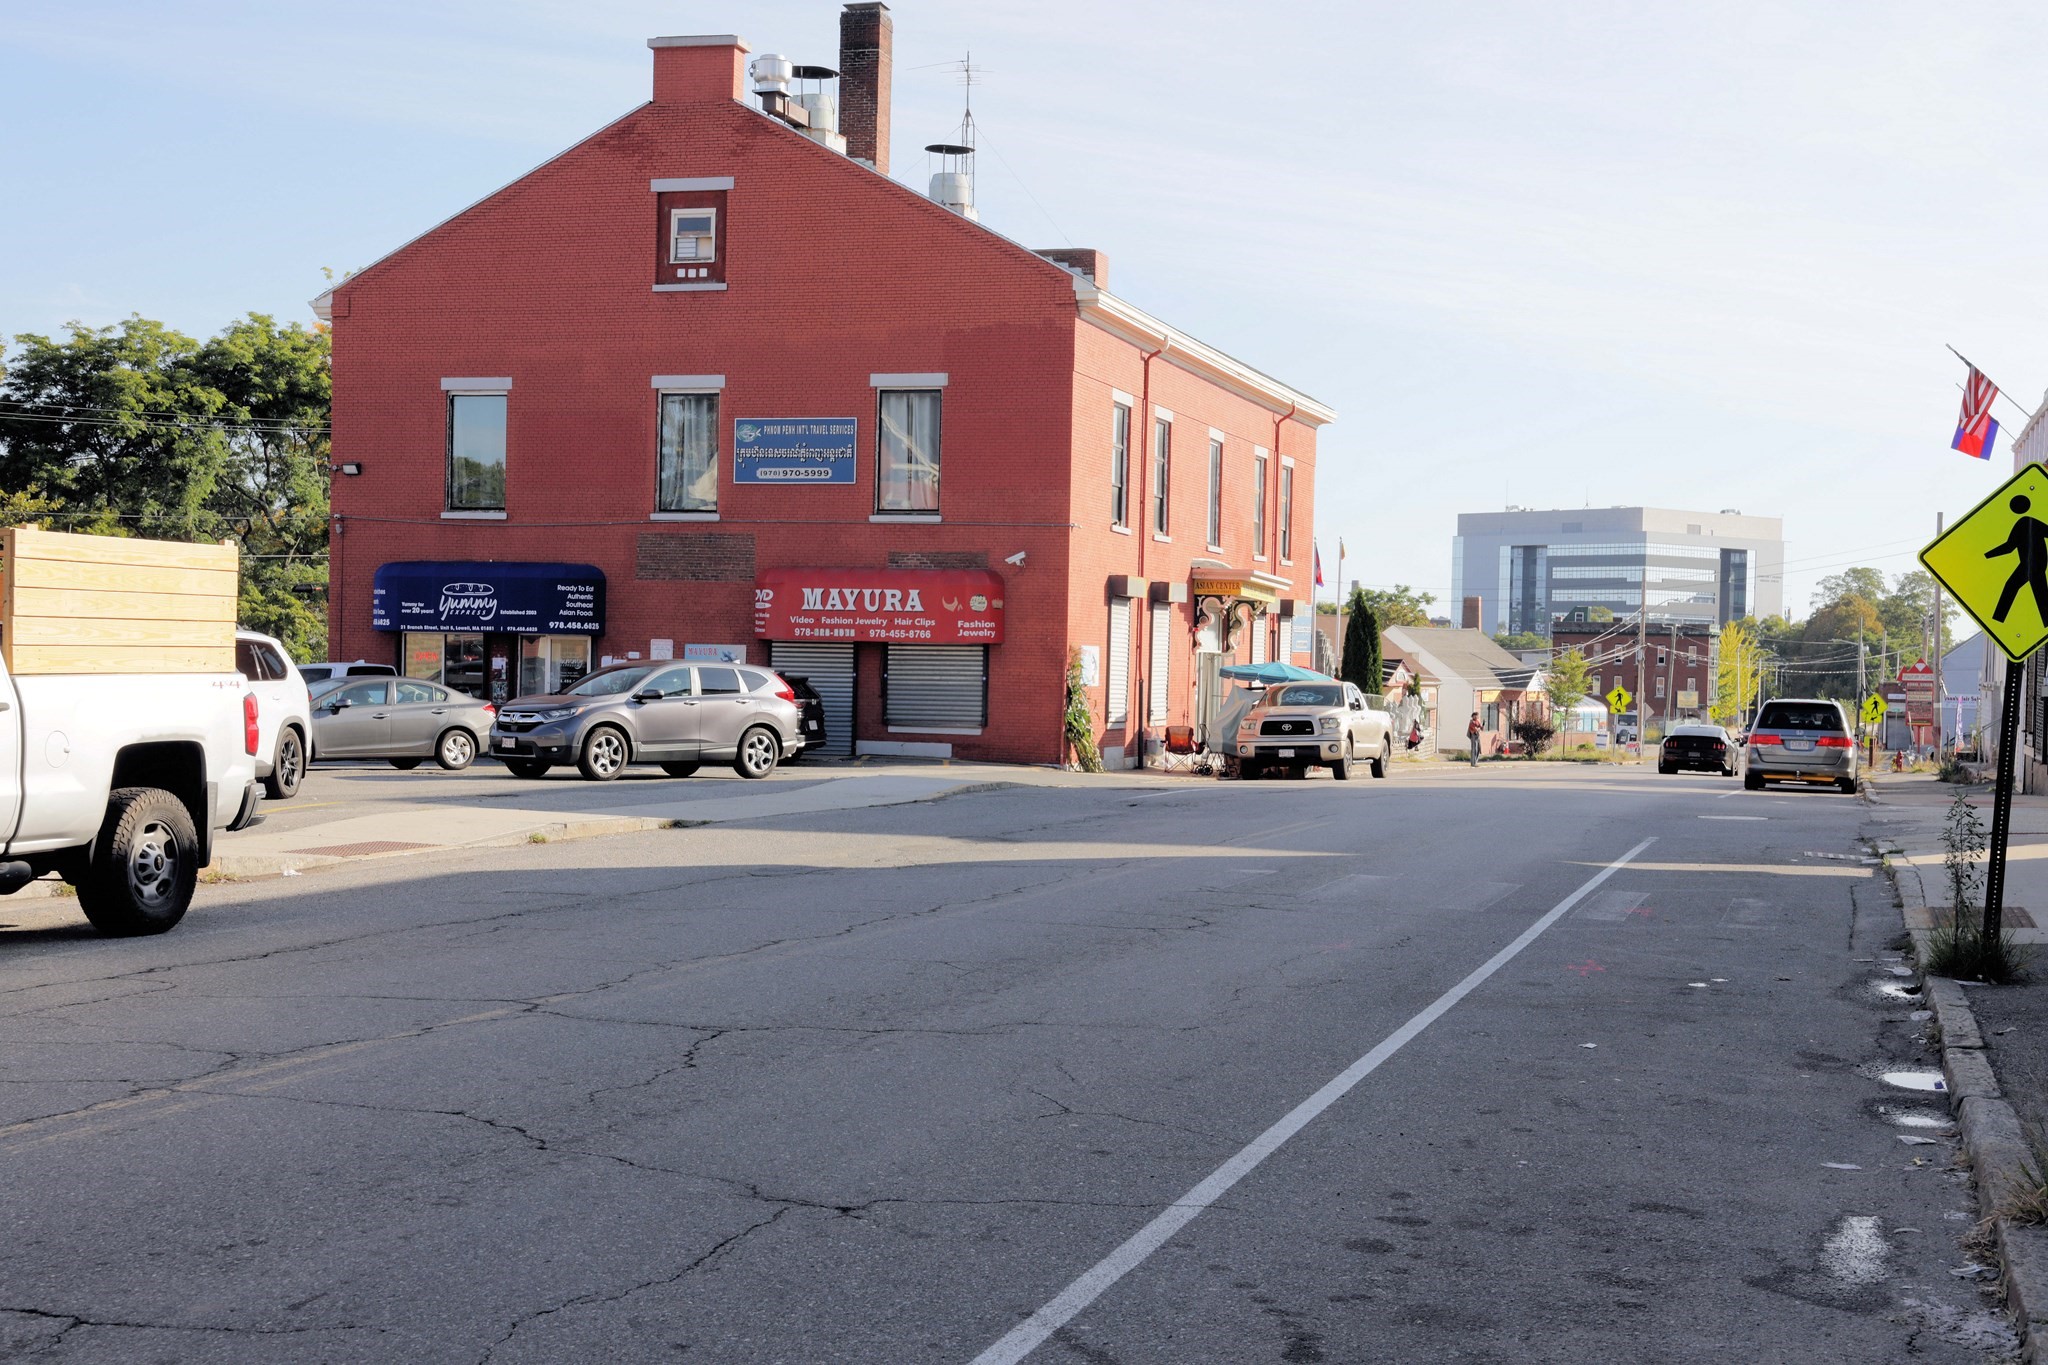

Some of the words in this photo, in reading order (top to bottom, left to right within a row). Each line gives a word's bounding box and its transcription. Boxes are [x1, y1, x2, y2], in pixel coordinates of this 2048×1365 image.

[782, 425, 796, 435] PENH
[810, 425, 828, 435] TRAVEL
[829, 425, 854, 435] SERVICES
[782, 469, 829, 477] 970-5999
[1195, 581, 1214, 589] ASIAN
[1216, 581, 1240, 589] CENTER
[801, 587, 924, 612] MAYURA
[439, 594, 498, 621] Yummy
[549, 621, 599, 630] 978.458.6825
[790, 616, 814, 624] Video
[821, 617, 853, 625] Fashion
[855, 617, 888, 627] Jewelry
[894, 617, 912, 625] Hair
[914, 618, 936, 627] Clips
[957, 620, 995, 628] Fashion
[869, 629, 931, 638] 978-455-8766
[957, 629, 996, 638] Jewelry
[414, 651, 438, 661] OPEN
[688, 647, 718, 656] MAYURA
